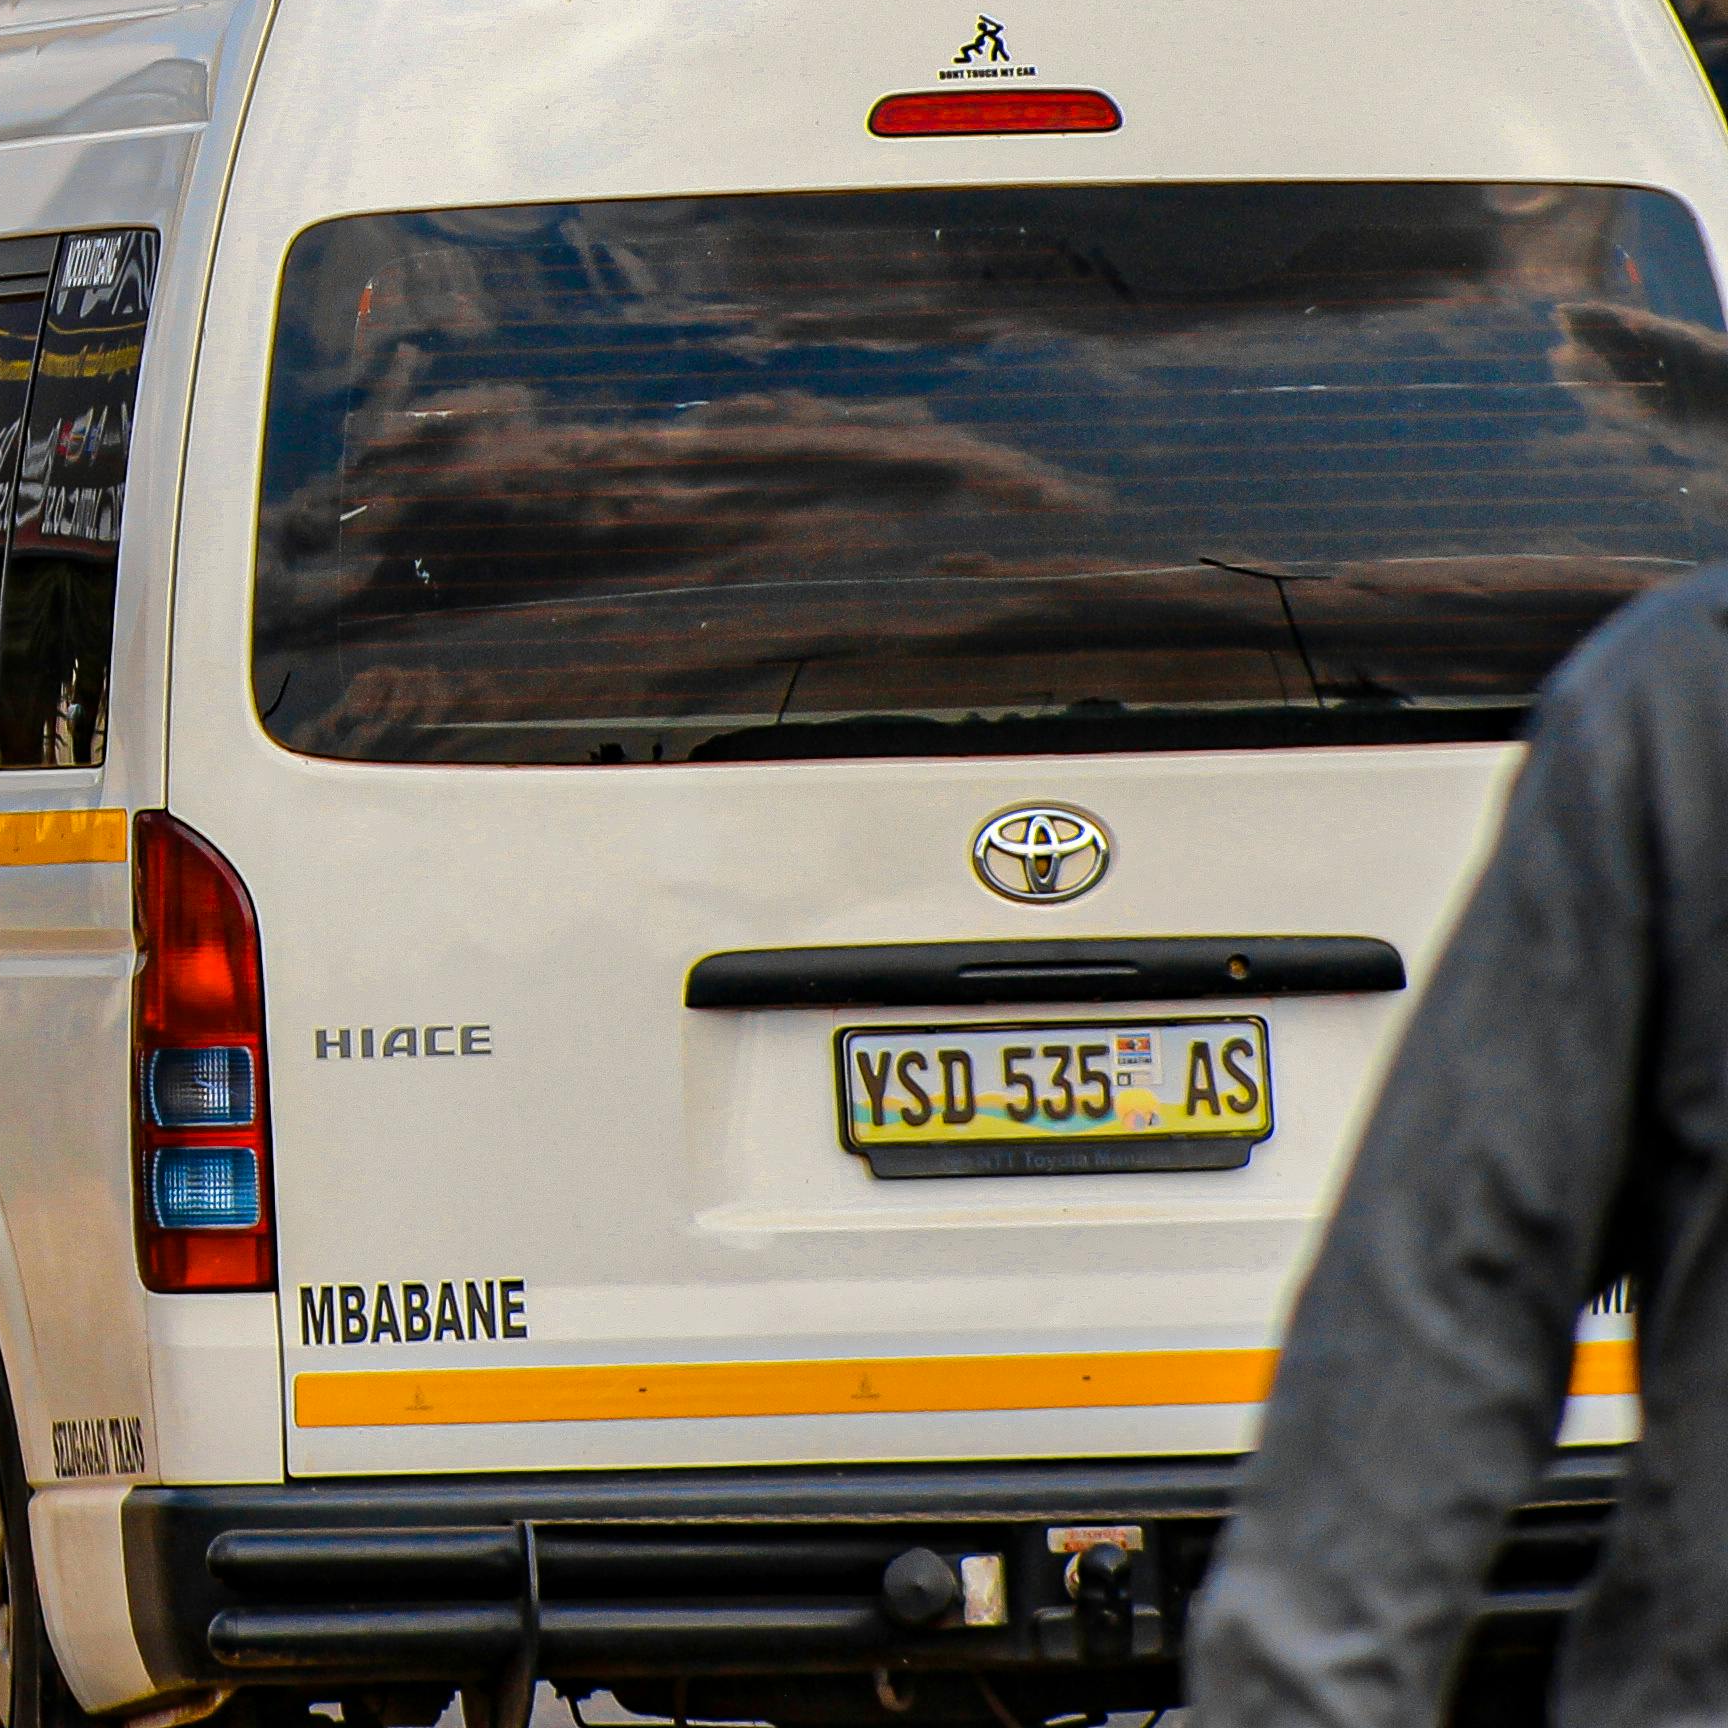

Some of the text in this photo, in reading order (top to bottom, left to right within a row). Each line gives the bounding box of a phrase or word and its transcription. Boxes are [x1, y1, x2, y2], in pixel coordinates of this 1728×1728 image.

[966, 68, 998, 79] TOUCH
[1000, 68, 1014, 77] MY
[1016, 67, 1036, 77] CAR
[314, 1024, 493, 1059] HIACE
[855, 1037, 1260, 1127] YSD 535 AS
[298, 1278, 529, 1346] MBABANE
[109, 1416, 146, 1474] TRANS
